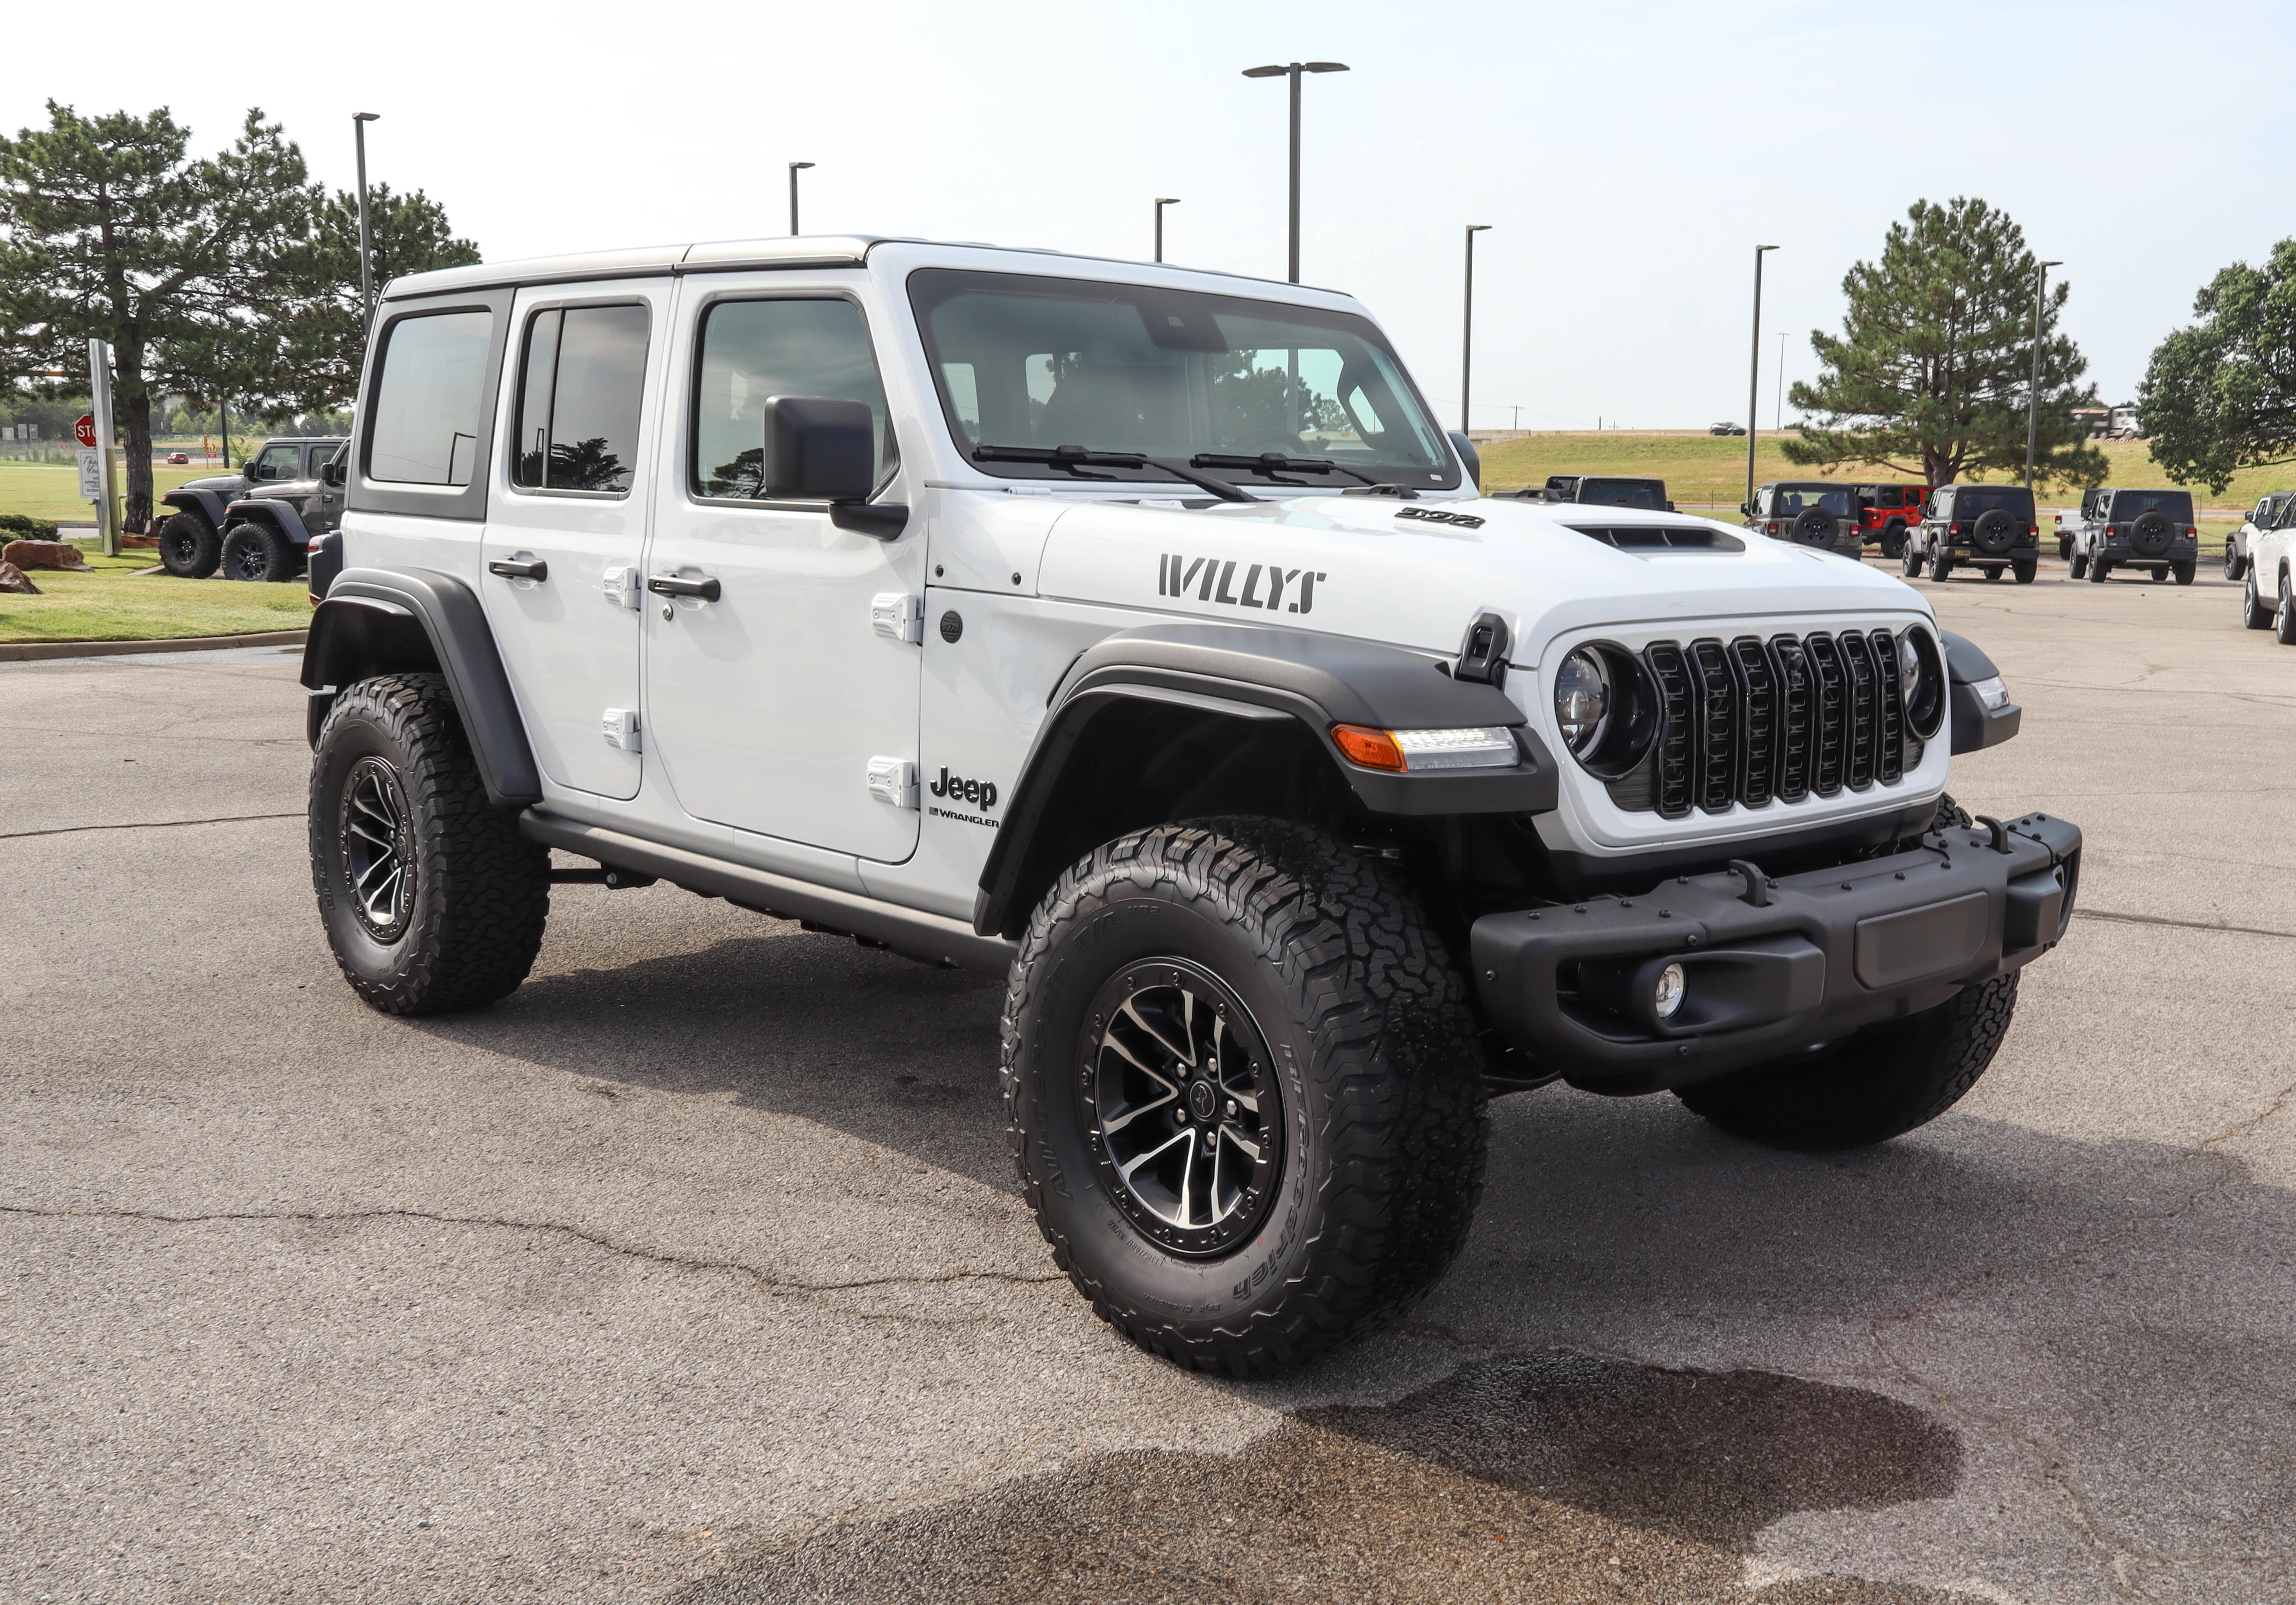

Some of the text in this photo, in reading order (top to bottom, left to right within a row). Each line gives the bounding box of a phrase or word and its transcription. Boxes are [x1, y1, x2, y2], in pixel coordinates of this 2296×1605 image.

[1394, 507, 1485, 529] 392
[1159, 553, 1327, 614] WILLYS
[930, 764, 997, 812] Jeep
[939, 809, 1000, 828] WRANGLER
